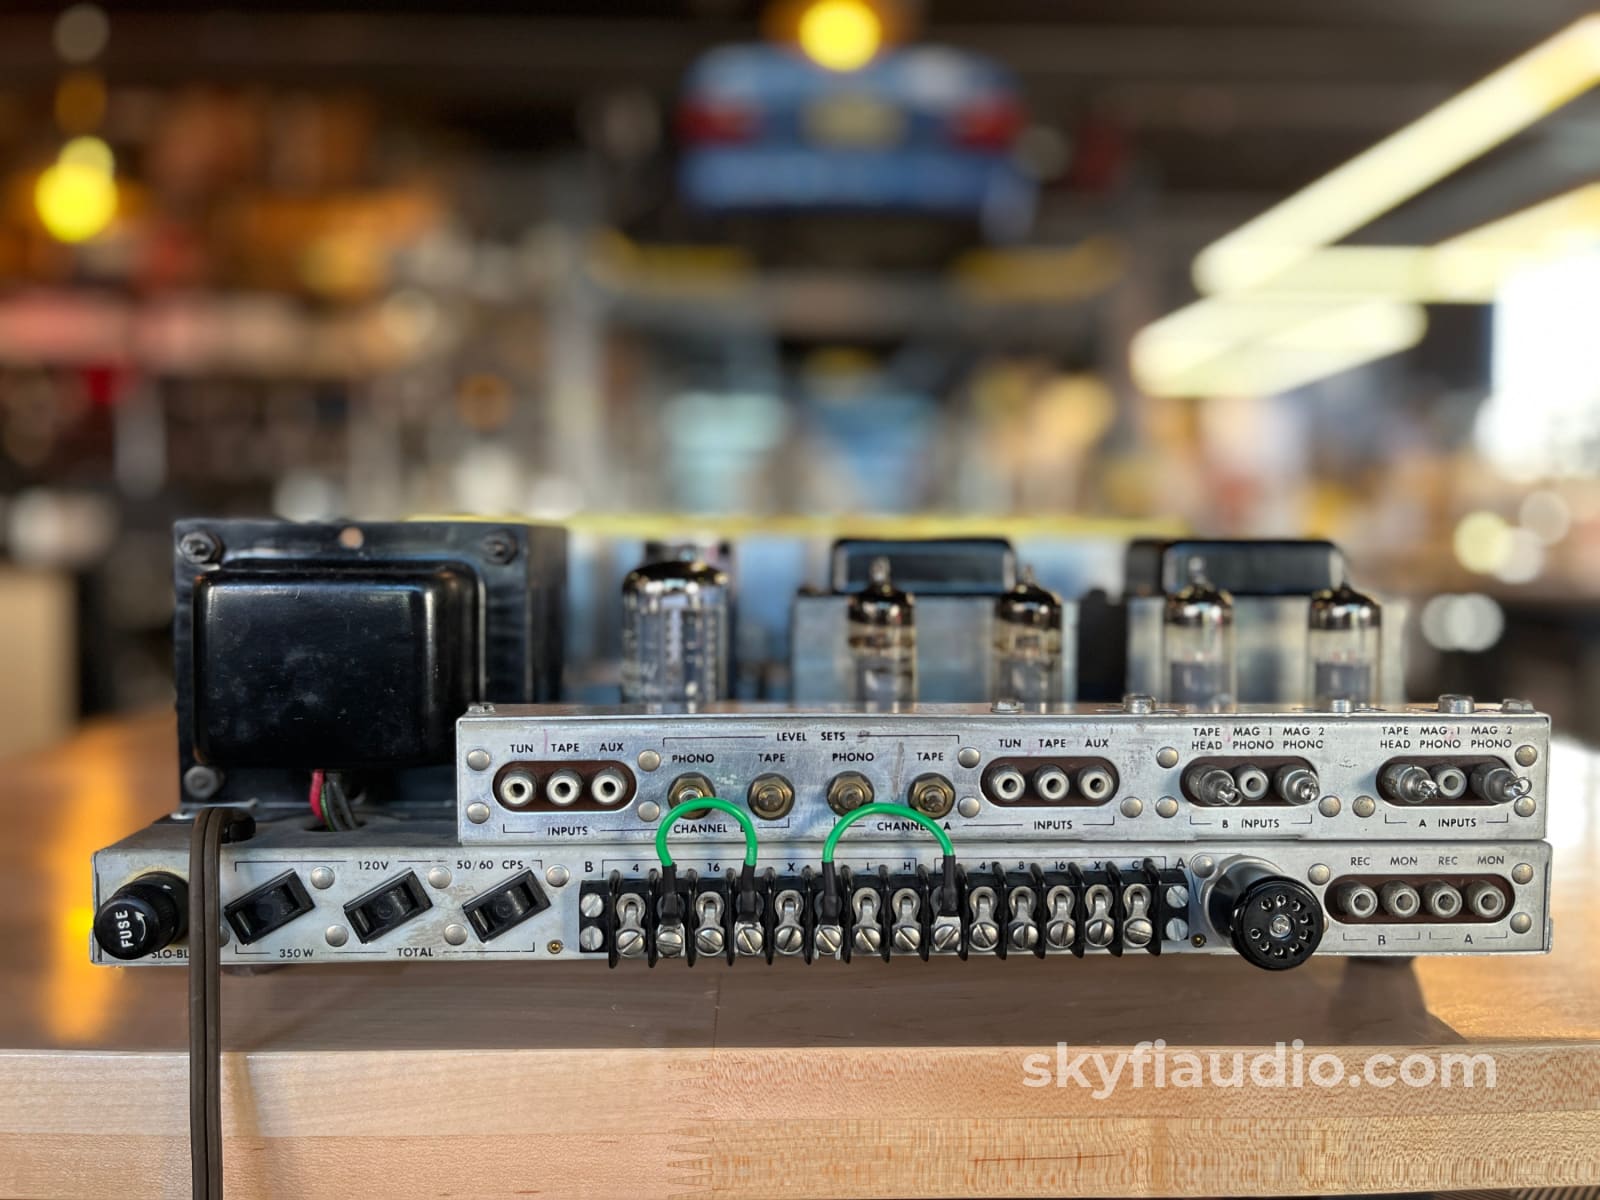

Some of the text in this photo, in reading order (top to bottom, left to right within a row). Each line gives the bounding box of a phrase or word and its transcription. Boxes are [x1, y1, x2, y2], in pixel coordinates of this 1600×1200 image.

[1192, 727, 1220, 737] TAPE
[1232, 726, 1261, 737] MAG
[1282, 726, 1325, 737] MAG 2
[1381, 726, 1409, 736] TAPE
[1419, 726, 1448, 736] MAG
[1470, 725, 1513, 735] MAG 2
[776, 731, 846, 742] LEVEL SETS
[509, 742, 624, 754] TUN TAPE AUX
[998, 738, 1109, 749] TUN TAPE AUX
[1191, 740, 1223, 751] HEAD
[1232, 739, 1275, 750] PHONO
[1379, 739, 1411, 749] HEAD
[1419, 739, 1462, 749] PHONO
[1470, 738, 1513, 749] PHONO
[671, 753, 715, 764] PHONO
[757, 753, 786, 763] TAPE
[831, 752, 875, 762] PHONO
[916, 751, 944, 762] TAPE
[877, 821, 952, 832] CHANNE A
[1033, 819, 1073, 831] INPUTS
[1222, 818, 1280, 829] B INPUTS
[1418, 817, 1477, 828] A INPUTS
[547, 825, 588, 836] INPUTS
[672, 823, 729, 834] CHANNEL
[358, 859, 524, 871] 120V 50/60 CPS
[903, 861, 912, 871] H
[979, 860, 1140, 871] 4 8 16 X C
[1175, 857, 1186, 870] A
[1350, 856, 1418, 866] REC MON
[1438, 855, 1505, 866] REC MON
[584, 860, 594, 873] B
[632, 862, 796, 873] 4 16 X
[115, 909, 135, 948] FUSE
[1377, 934, 1386, 946] B
[1463, 933, 1474, 945] A
[396, 947, 434, 958] TOTAL
